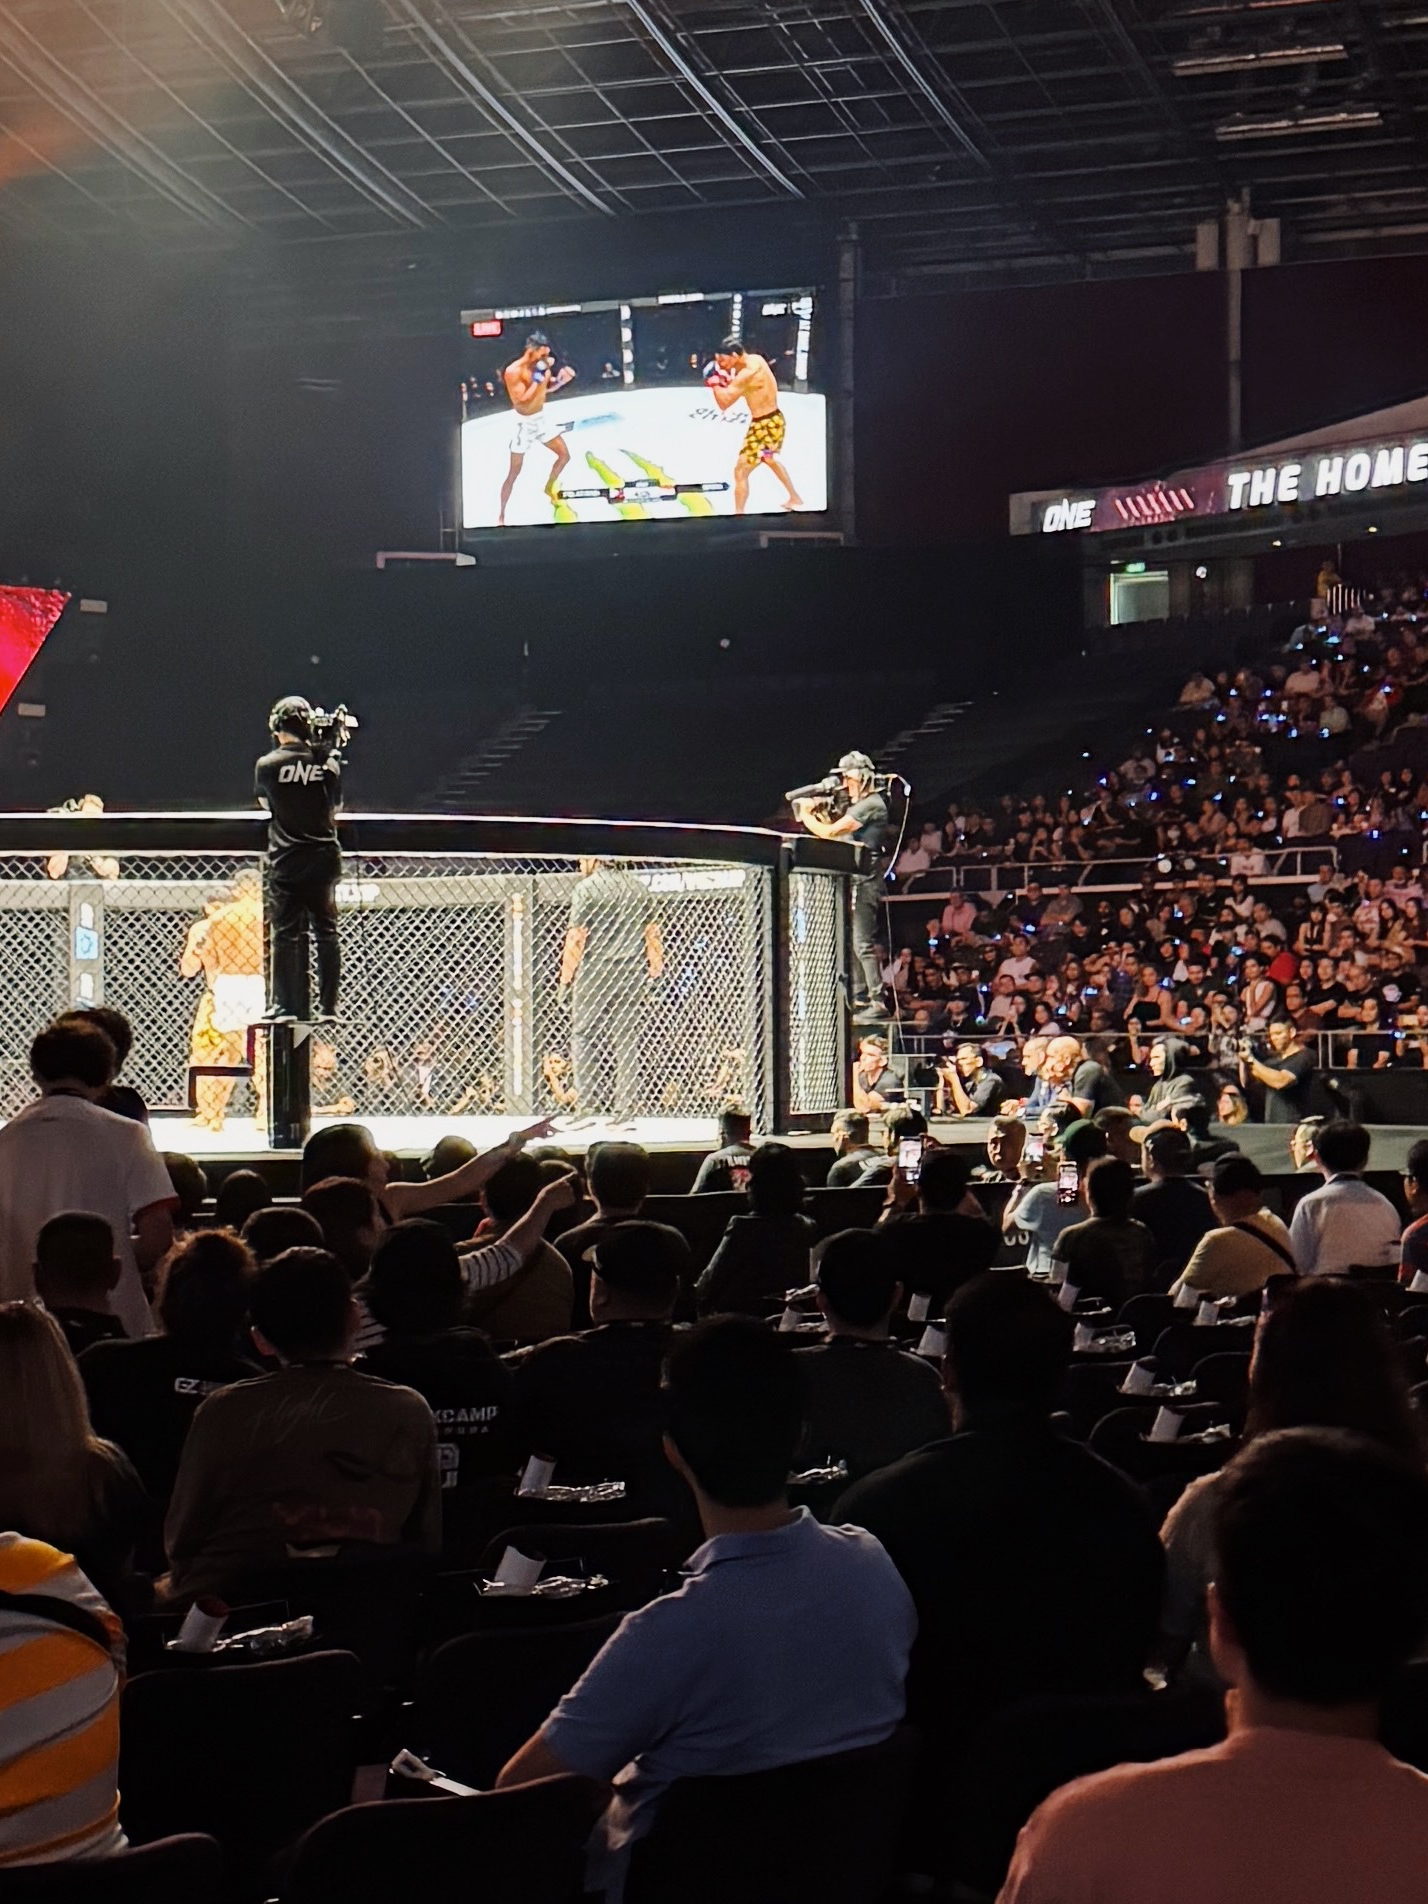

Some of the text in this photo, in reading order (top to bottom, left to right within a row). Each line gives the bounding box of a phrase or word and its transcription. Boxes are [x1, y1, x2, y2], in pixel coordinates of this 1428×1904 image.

[1043, 498, 1096, 533] ONE
[1228, 464, 1301, 510] THE
[277, 760, 325, 786] ONE
